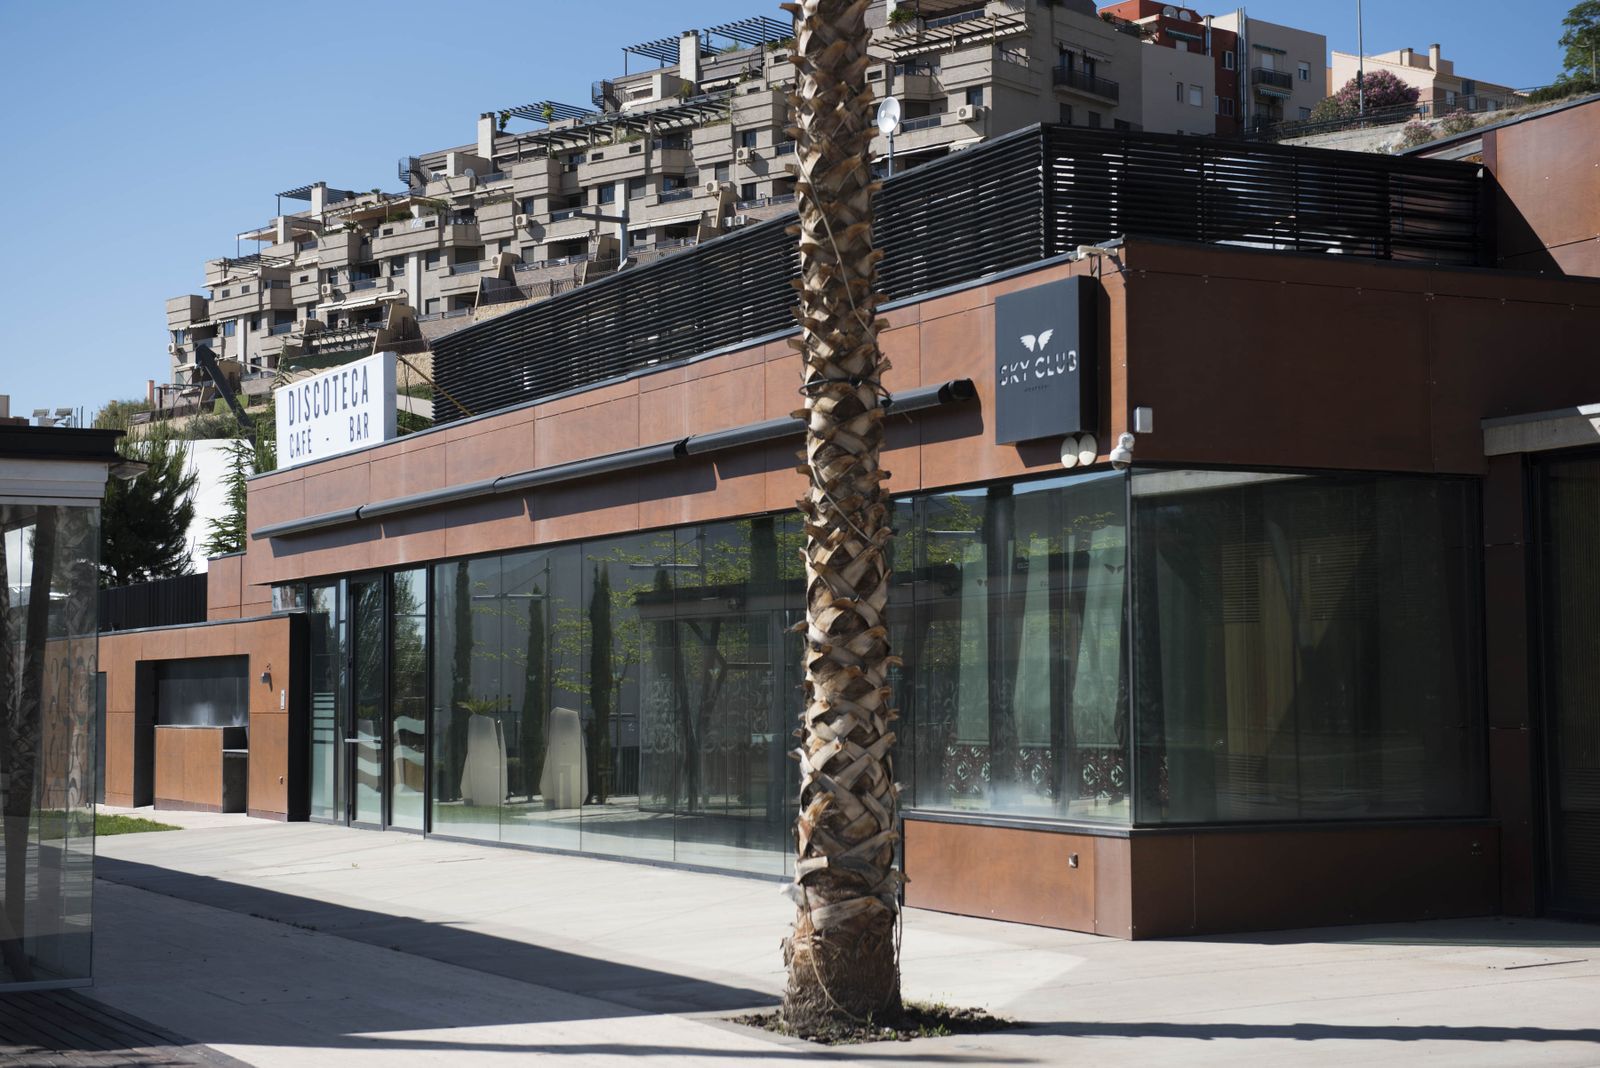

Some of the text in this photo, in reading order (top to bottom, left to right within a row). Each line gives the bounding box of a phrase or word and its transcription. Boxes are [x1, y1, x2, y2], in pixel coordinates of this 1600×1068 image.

[1001, 350, 1077, 386] SKY CLUB
[289, 365, 368, 426] DISCOTECA
[289, 425, 312, 458] CAFÉ
[349, 412, 369, 442] BAR
